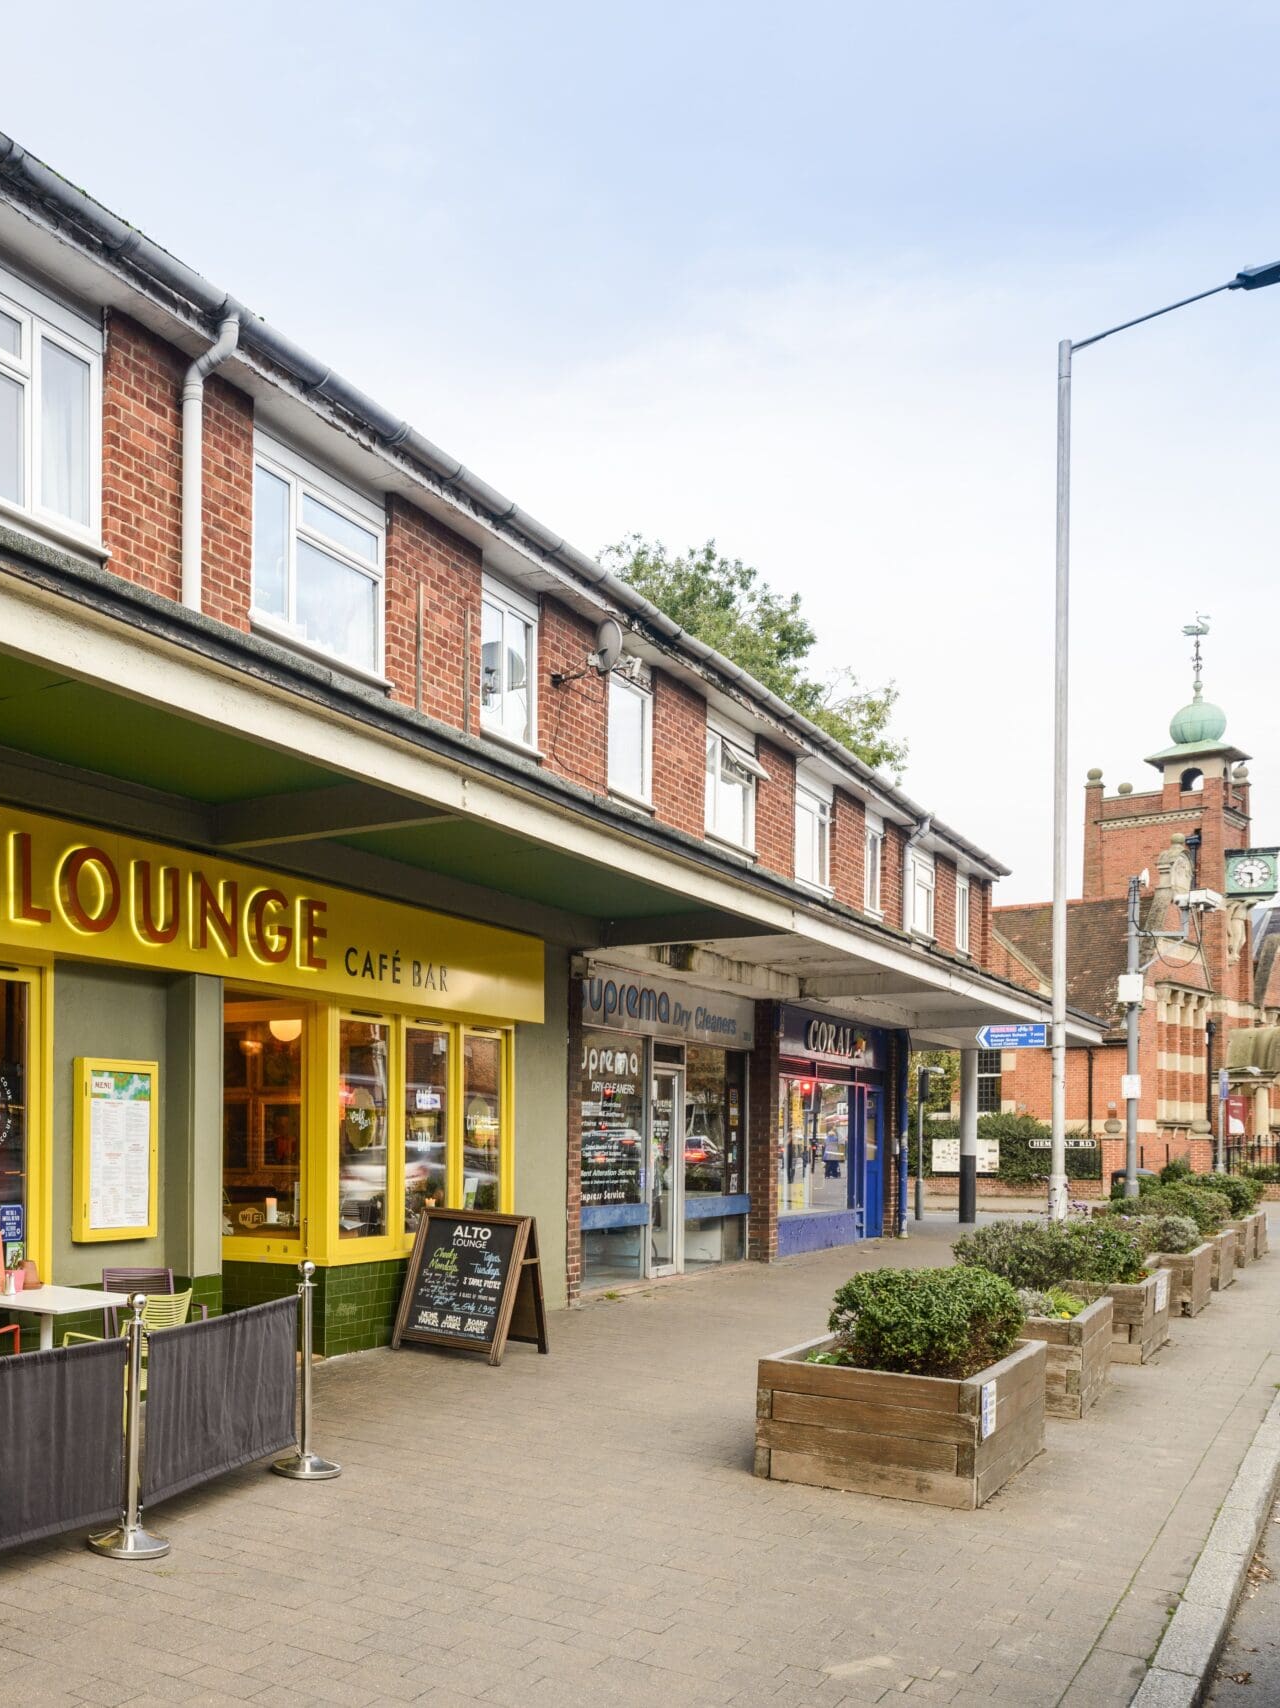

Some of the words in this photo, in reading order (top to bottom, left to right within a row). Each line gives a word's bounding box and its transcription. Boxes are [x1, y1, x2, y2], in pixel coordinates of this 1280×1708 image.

[8, 831, 328, 971] LOUNGE
[344, 947, 402, 985] CAFÉ
[411, 960, 449, 993] BAR
[673, 1001, 692, 1032] Dry
[695, 1006, 737, 1035] Cleaners
[806, 1019, 853, 1057] CORAL
[95, 1081, 112, 1089] MENU
[592, 1169, 617, 1177] Alteration
[617, 1168, 636, 1176] Service
[603, 1190, 625, 1200] Service
[453, 1225, 492, 1240] ALTO
[452, 1238, 488, 1249] LOUNGE
